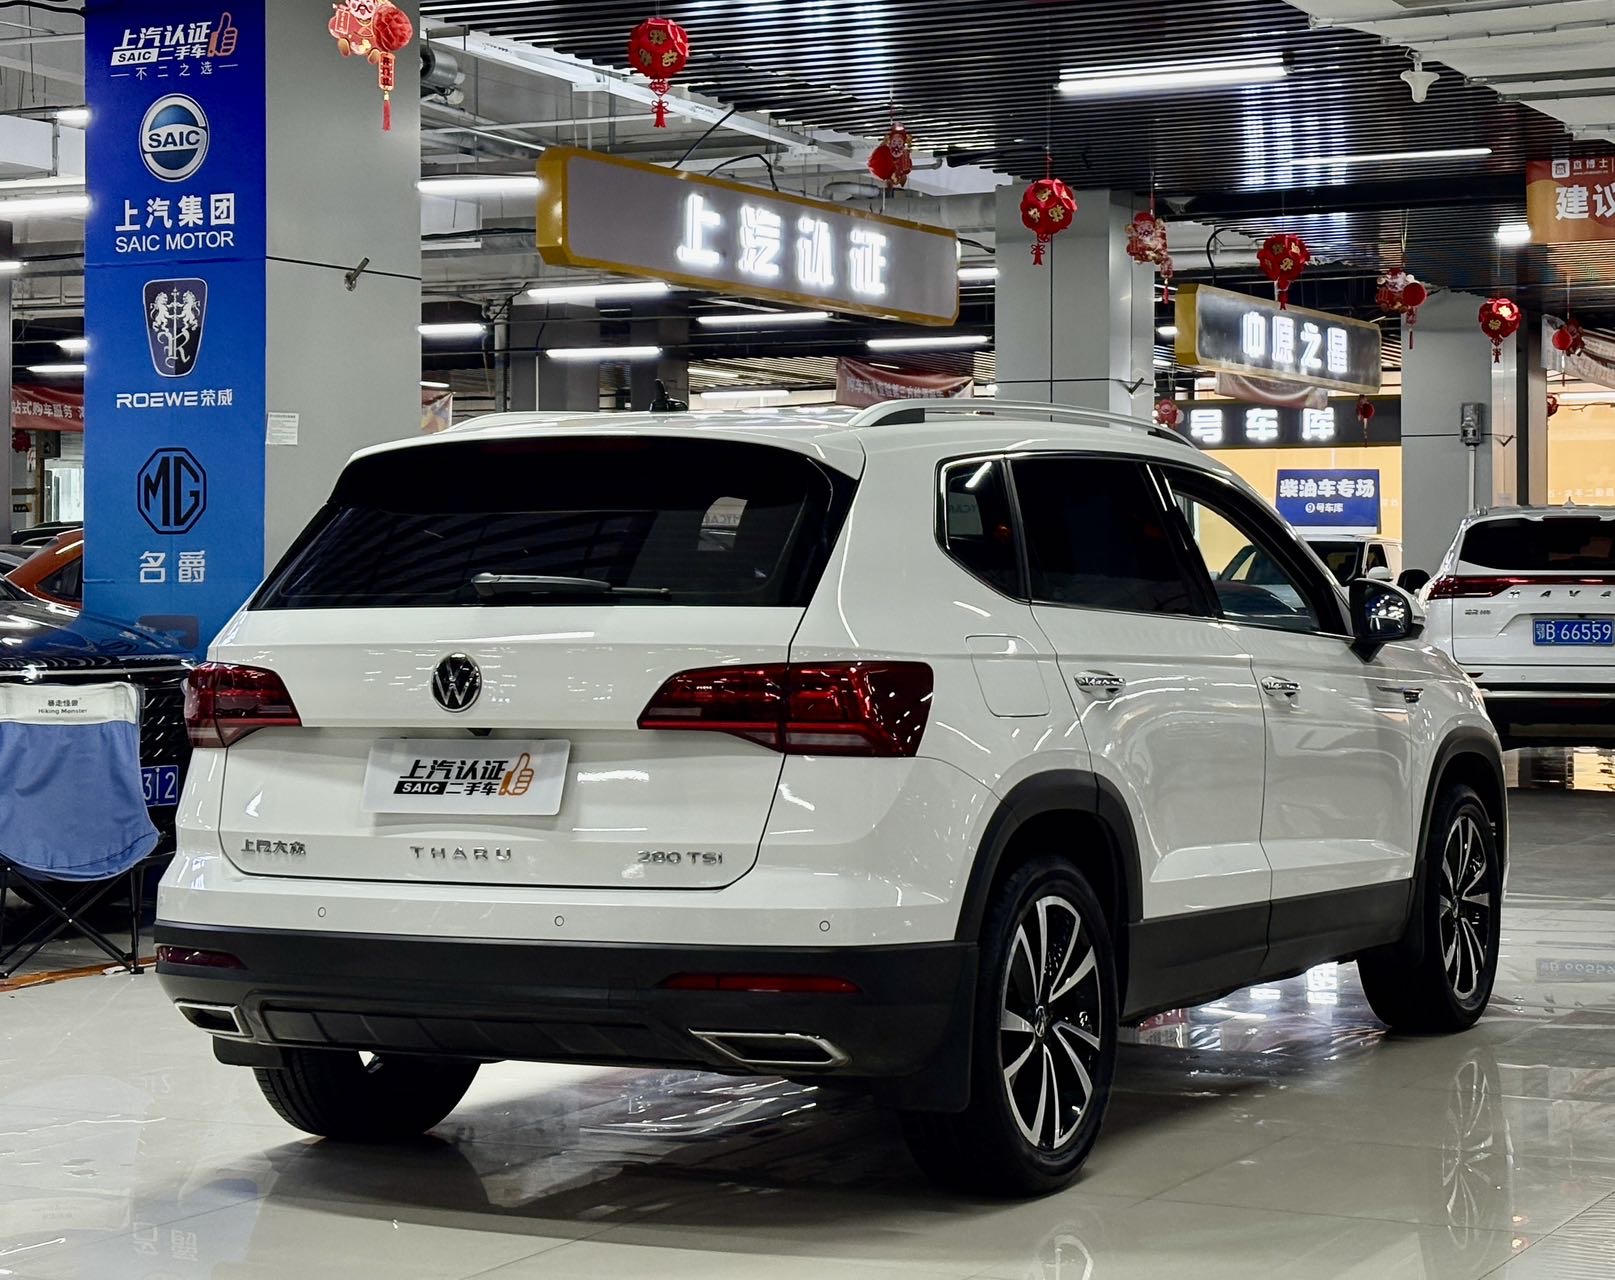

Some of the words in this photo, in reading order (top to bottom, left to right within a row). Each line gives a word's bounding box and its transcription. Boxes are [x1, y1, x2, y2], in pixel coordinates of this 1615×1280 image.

[113, 21, 213, 51] 上汽认证
[117, 50, 152, 63] SAIC
[158, 44, 208, 61] 二手车
[135, 60, 213, 81] 不二之选
[147, 129, 201, 149] SAIC
[115, 192, 235, 232] 上汽集团
[115, 234, 160, 253] SAIC
[165, 230, 235, 250] MOTOR
[676, 192, 887, 296] 上汽认证
[1241, 310, 1348, 375] 中原之星
[1279, 478, 1375, 498] 柴油车专场
[139, 550, 205, 583] 名爵
[400, 758, 509, 781] 上汽认证
[402, 782, 440, 794] SAIC
[445, 781, 499, 796] 二手车
[409, 845, 512, 862] THARU
[637, 849, 682, 865] 280
[686, 850, 724, 865] TSI
